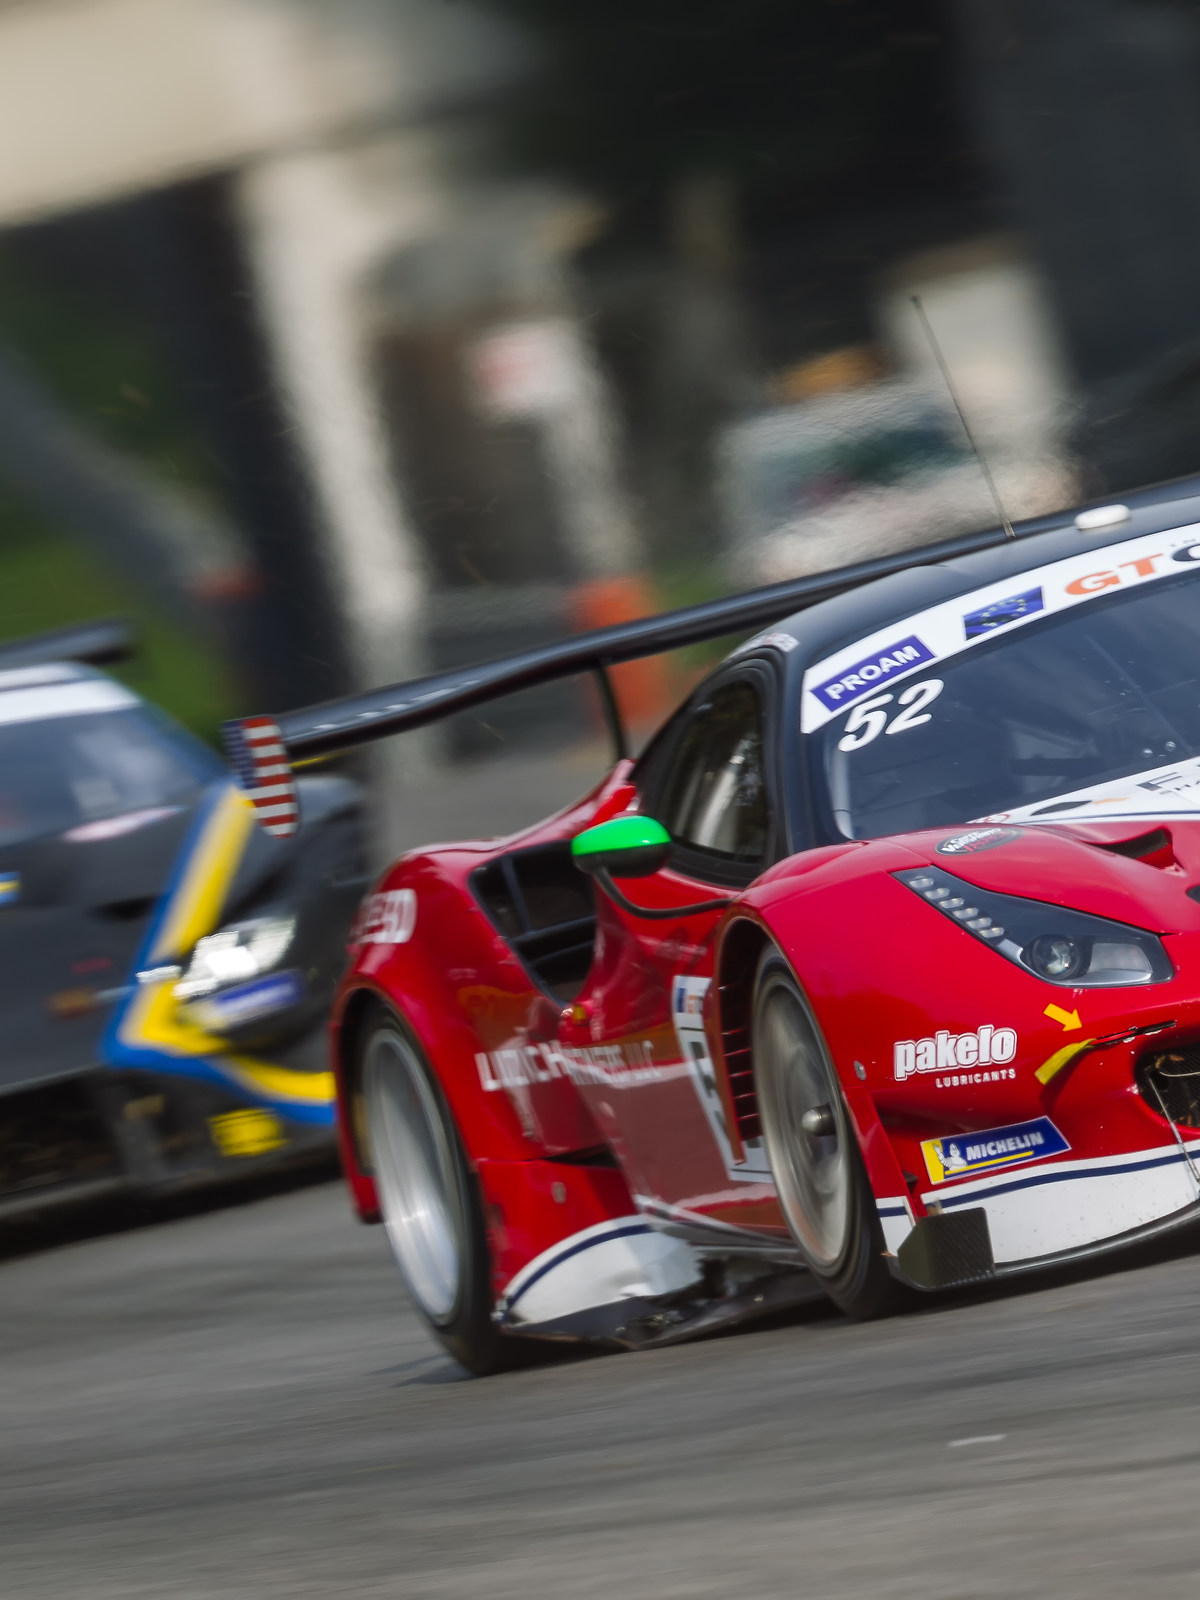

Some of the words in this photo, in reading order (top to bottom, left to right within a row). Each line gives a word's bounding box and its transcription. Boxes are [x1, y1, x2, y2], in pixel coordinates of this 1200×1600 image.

[824, 645, 921, 700] PROAM
[837, 678, 945, 752] 52
[894, 1024, 1018, 1081] pakelo
[935, 1068, 1016, 1088] LUBRICANTS
[965, 1131, 1045, 1161] MICHELIN
